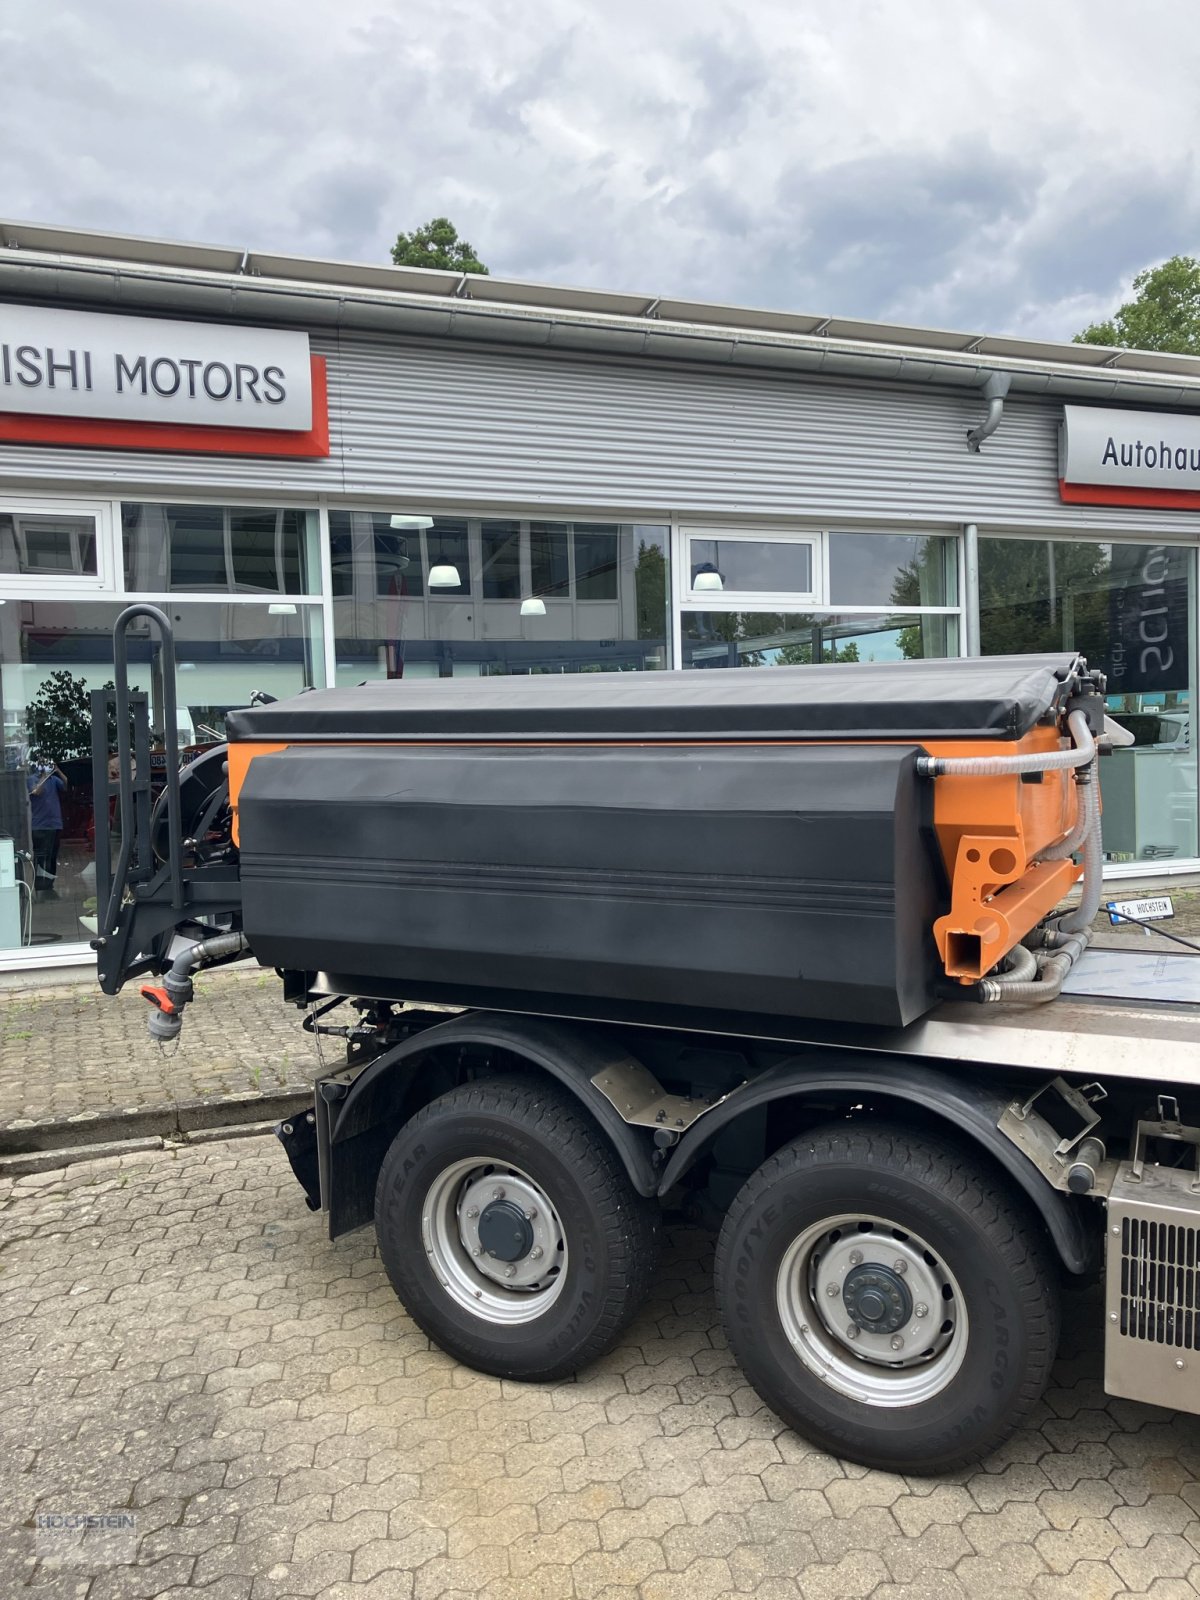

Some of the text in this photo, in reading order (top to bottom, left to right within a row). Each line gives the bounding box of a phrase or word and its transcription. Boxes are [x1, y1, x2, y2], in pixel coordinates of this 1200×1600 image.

[1, 343, 287, 405] ISHI MOTORS
[1101, 436, 1200, 471] Autohau
